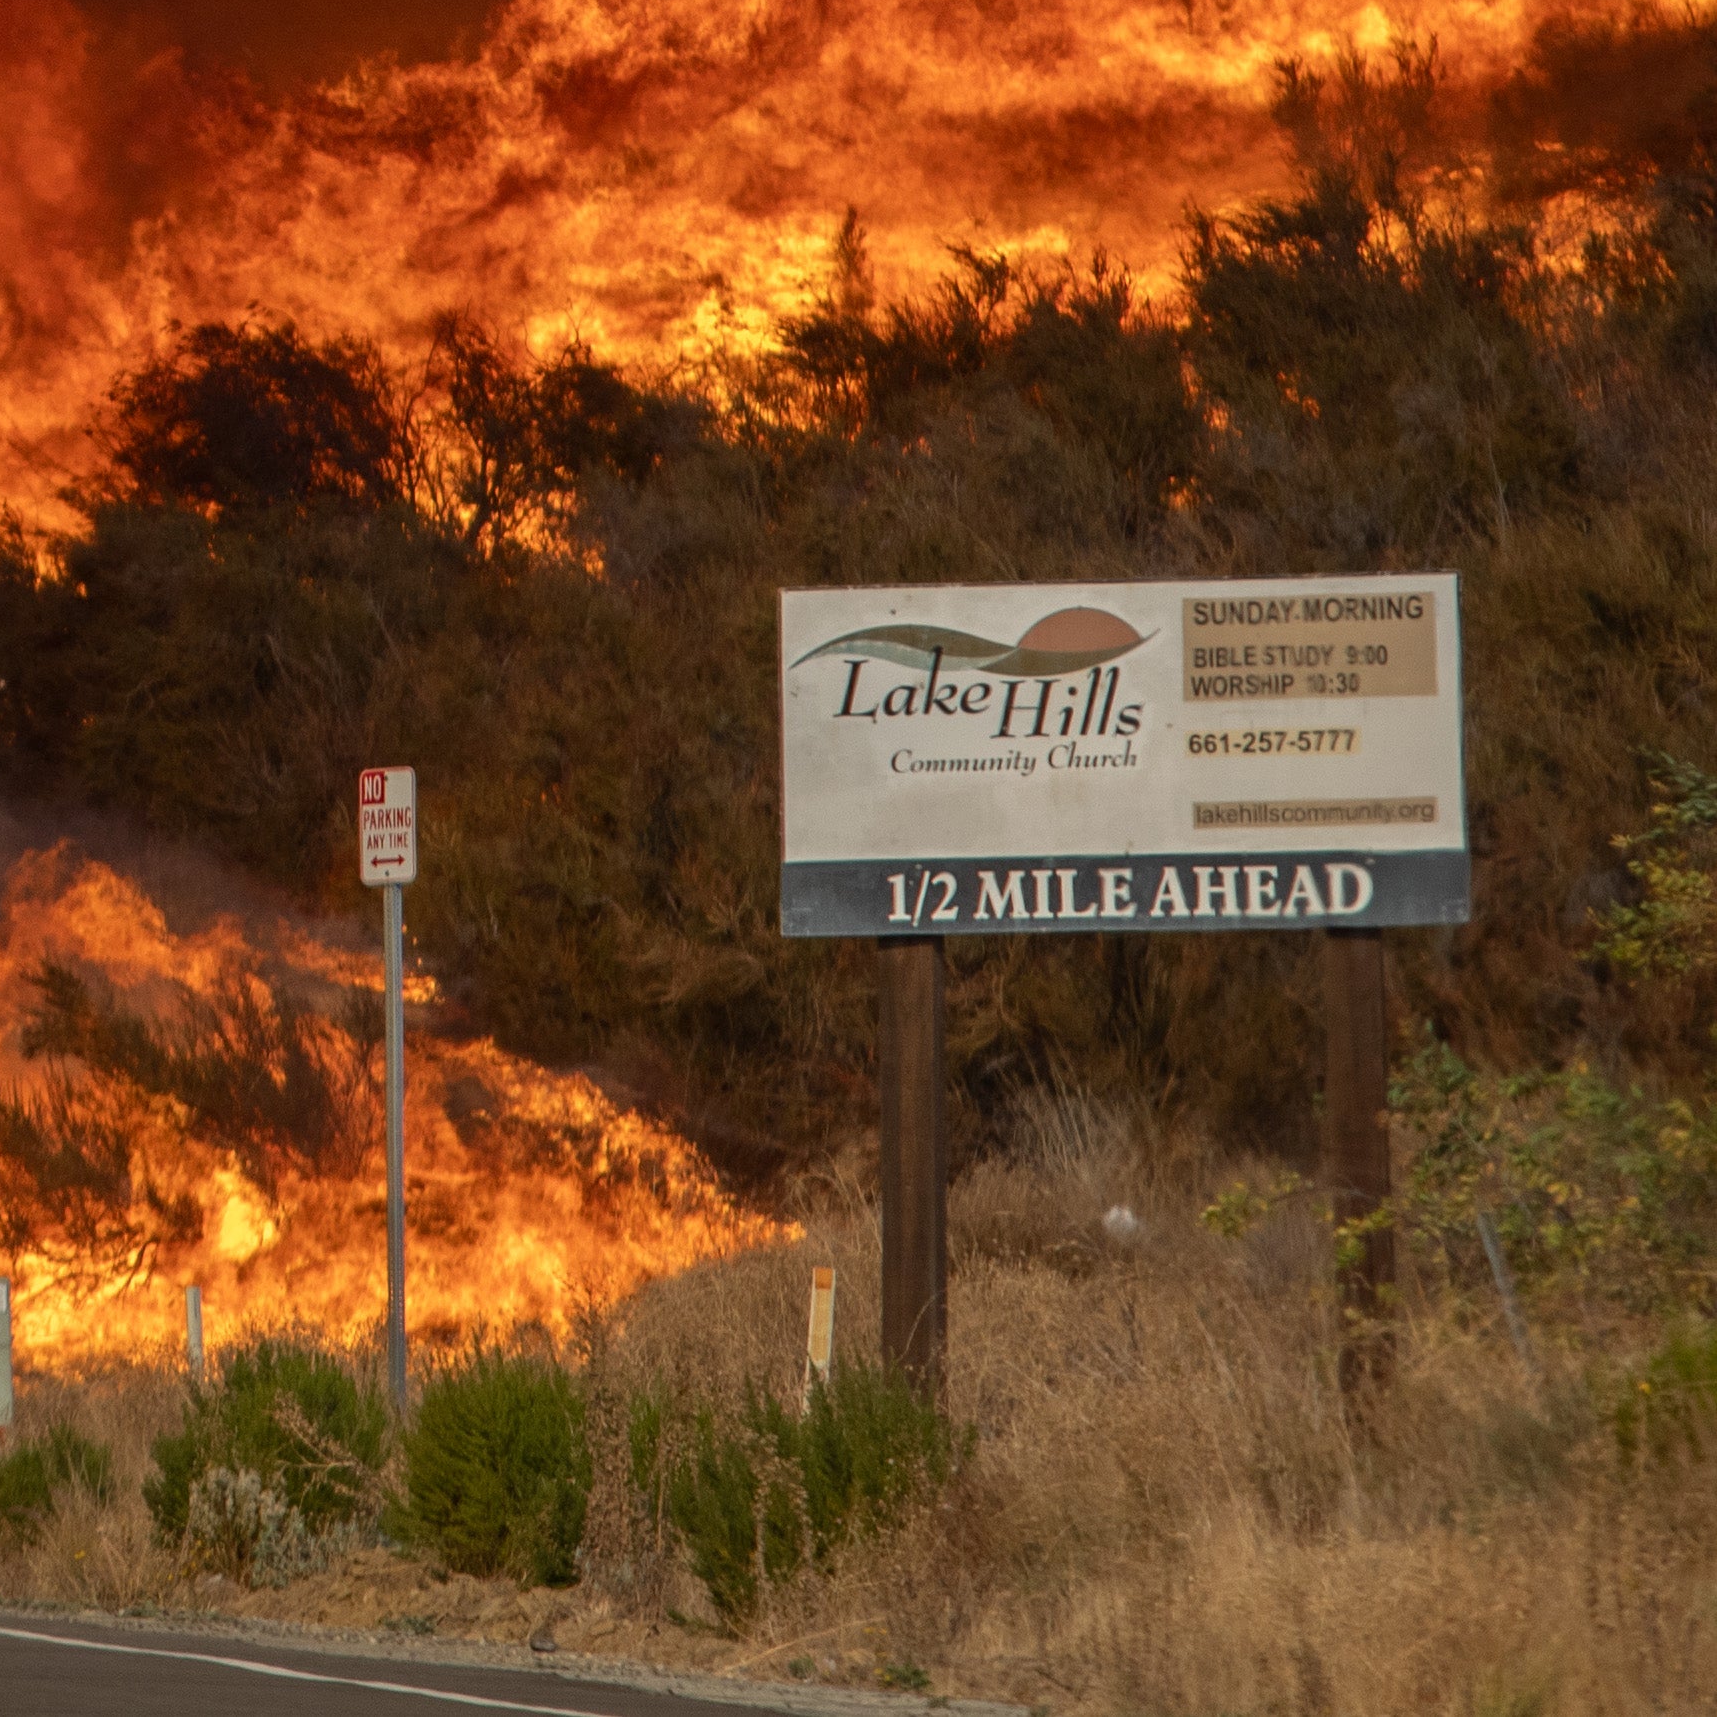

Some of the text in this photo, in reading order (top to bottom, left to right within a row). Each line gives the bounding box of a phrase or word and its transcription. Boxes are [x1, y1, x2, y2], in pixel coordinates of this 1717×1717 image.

[1193, 595, 1424, 625] SUNDAY MORNING
[1193, 645, 1388, 669] BIBLE STUDY 9:00
[833, 645, 1144, 738] Lake Hills
[1191, 674, 1295, 697] WORSHIP
[1189, 730, 1356, 754] 661-257-5777
[891, 741, 1137, 776] Community Church
[364, 774, 382, 801] NO
[363, 806, 412, 831] PARKING
[1195, 802, 1436, 825] lakehillscommunity.org
[367, 832, 409, 850] ANY TIME
[887, 862, 1374, 927] 1/2 MILE AHEAD
